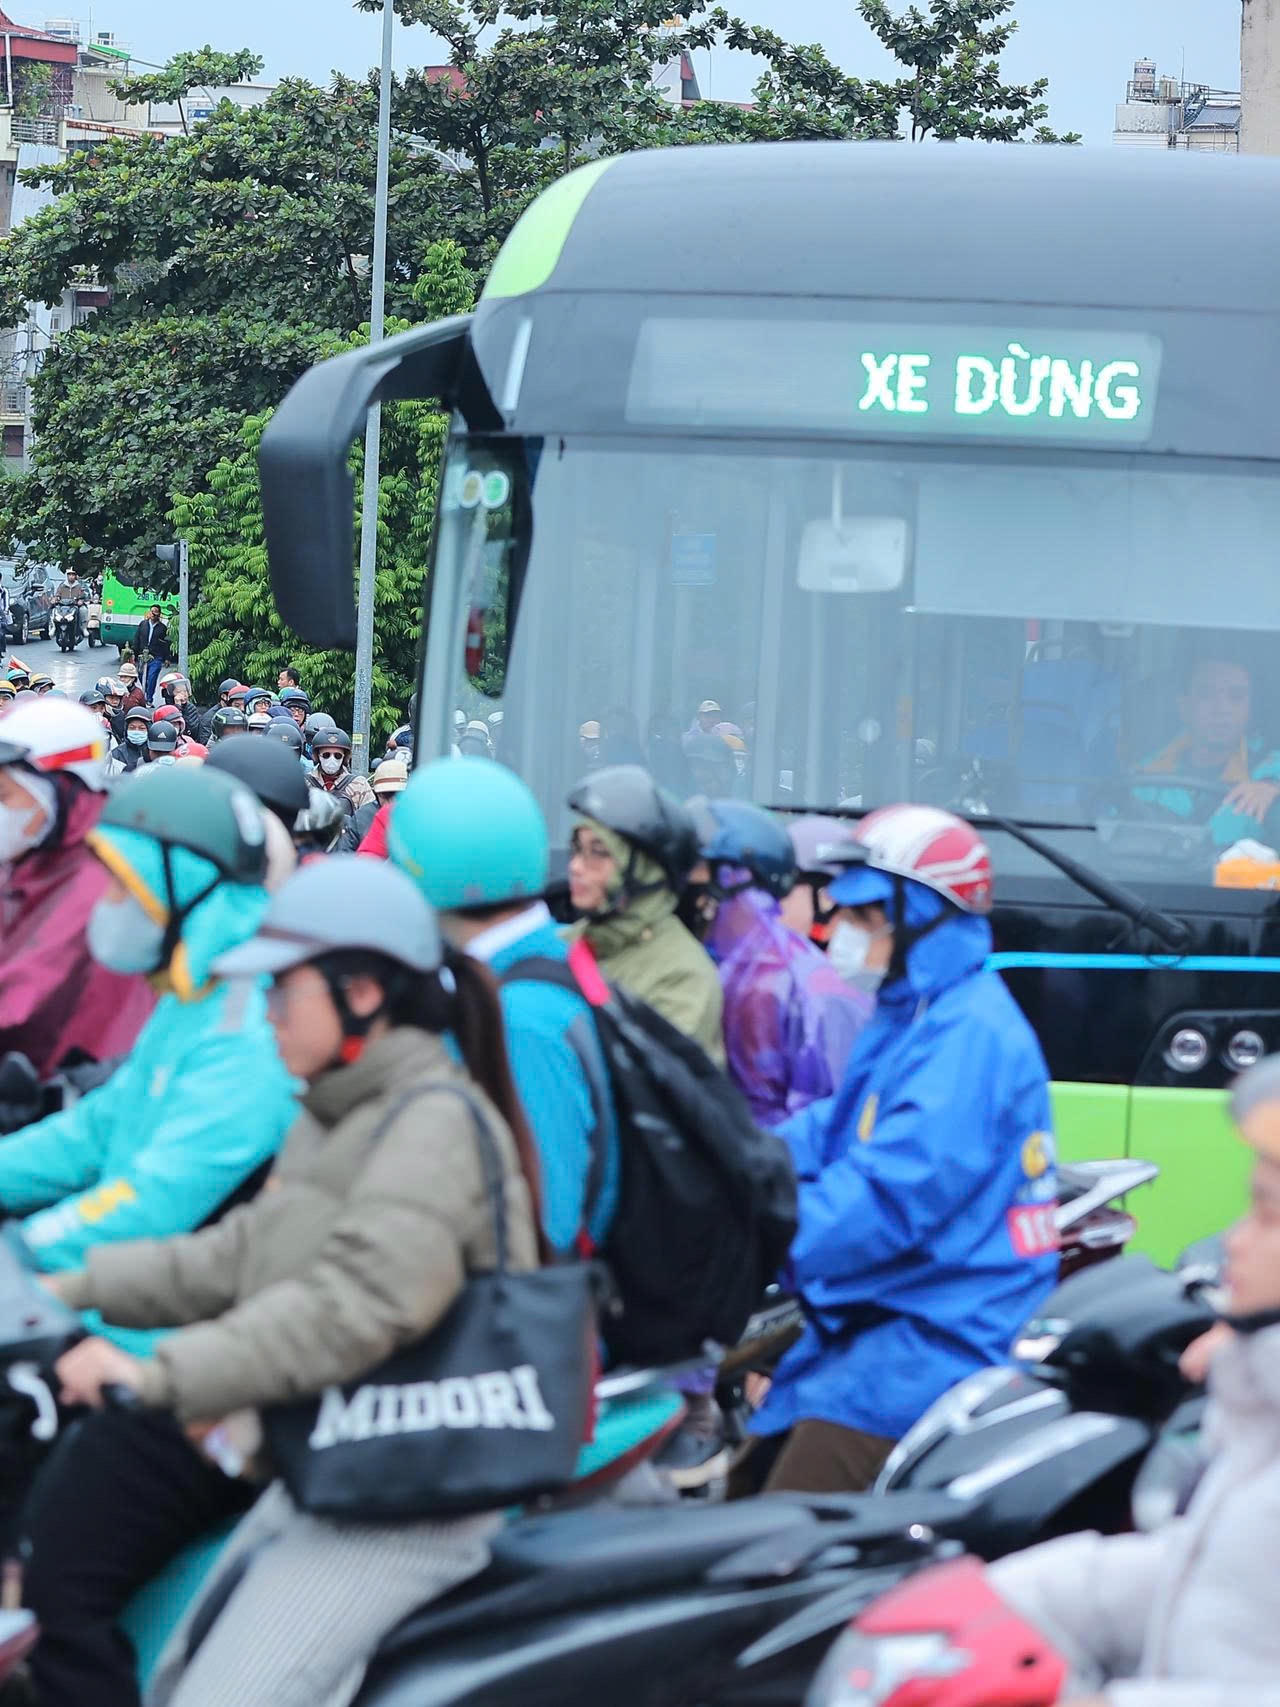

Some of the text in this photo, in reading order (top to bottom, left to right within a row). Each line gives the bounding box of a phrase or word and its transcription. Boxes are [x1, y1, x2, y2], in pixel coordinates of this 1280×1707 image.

[859, 343, 1142, 420] XE DỪNG
[309, 1364, 556, 1450] MIDORI
